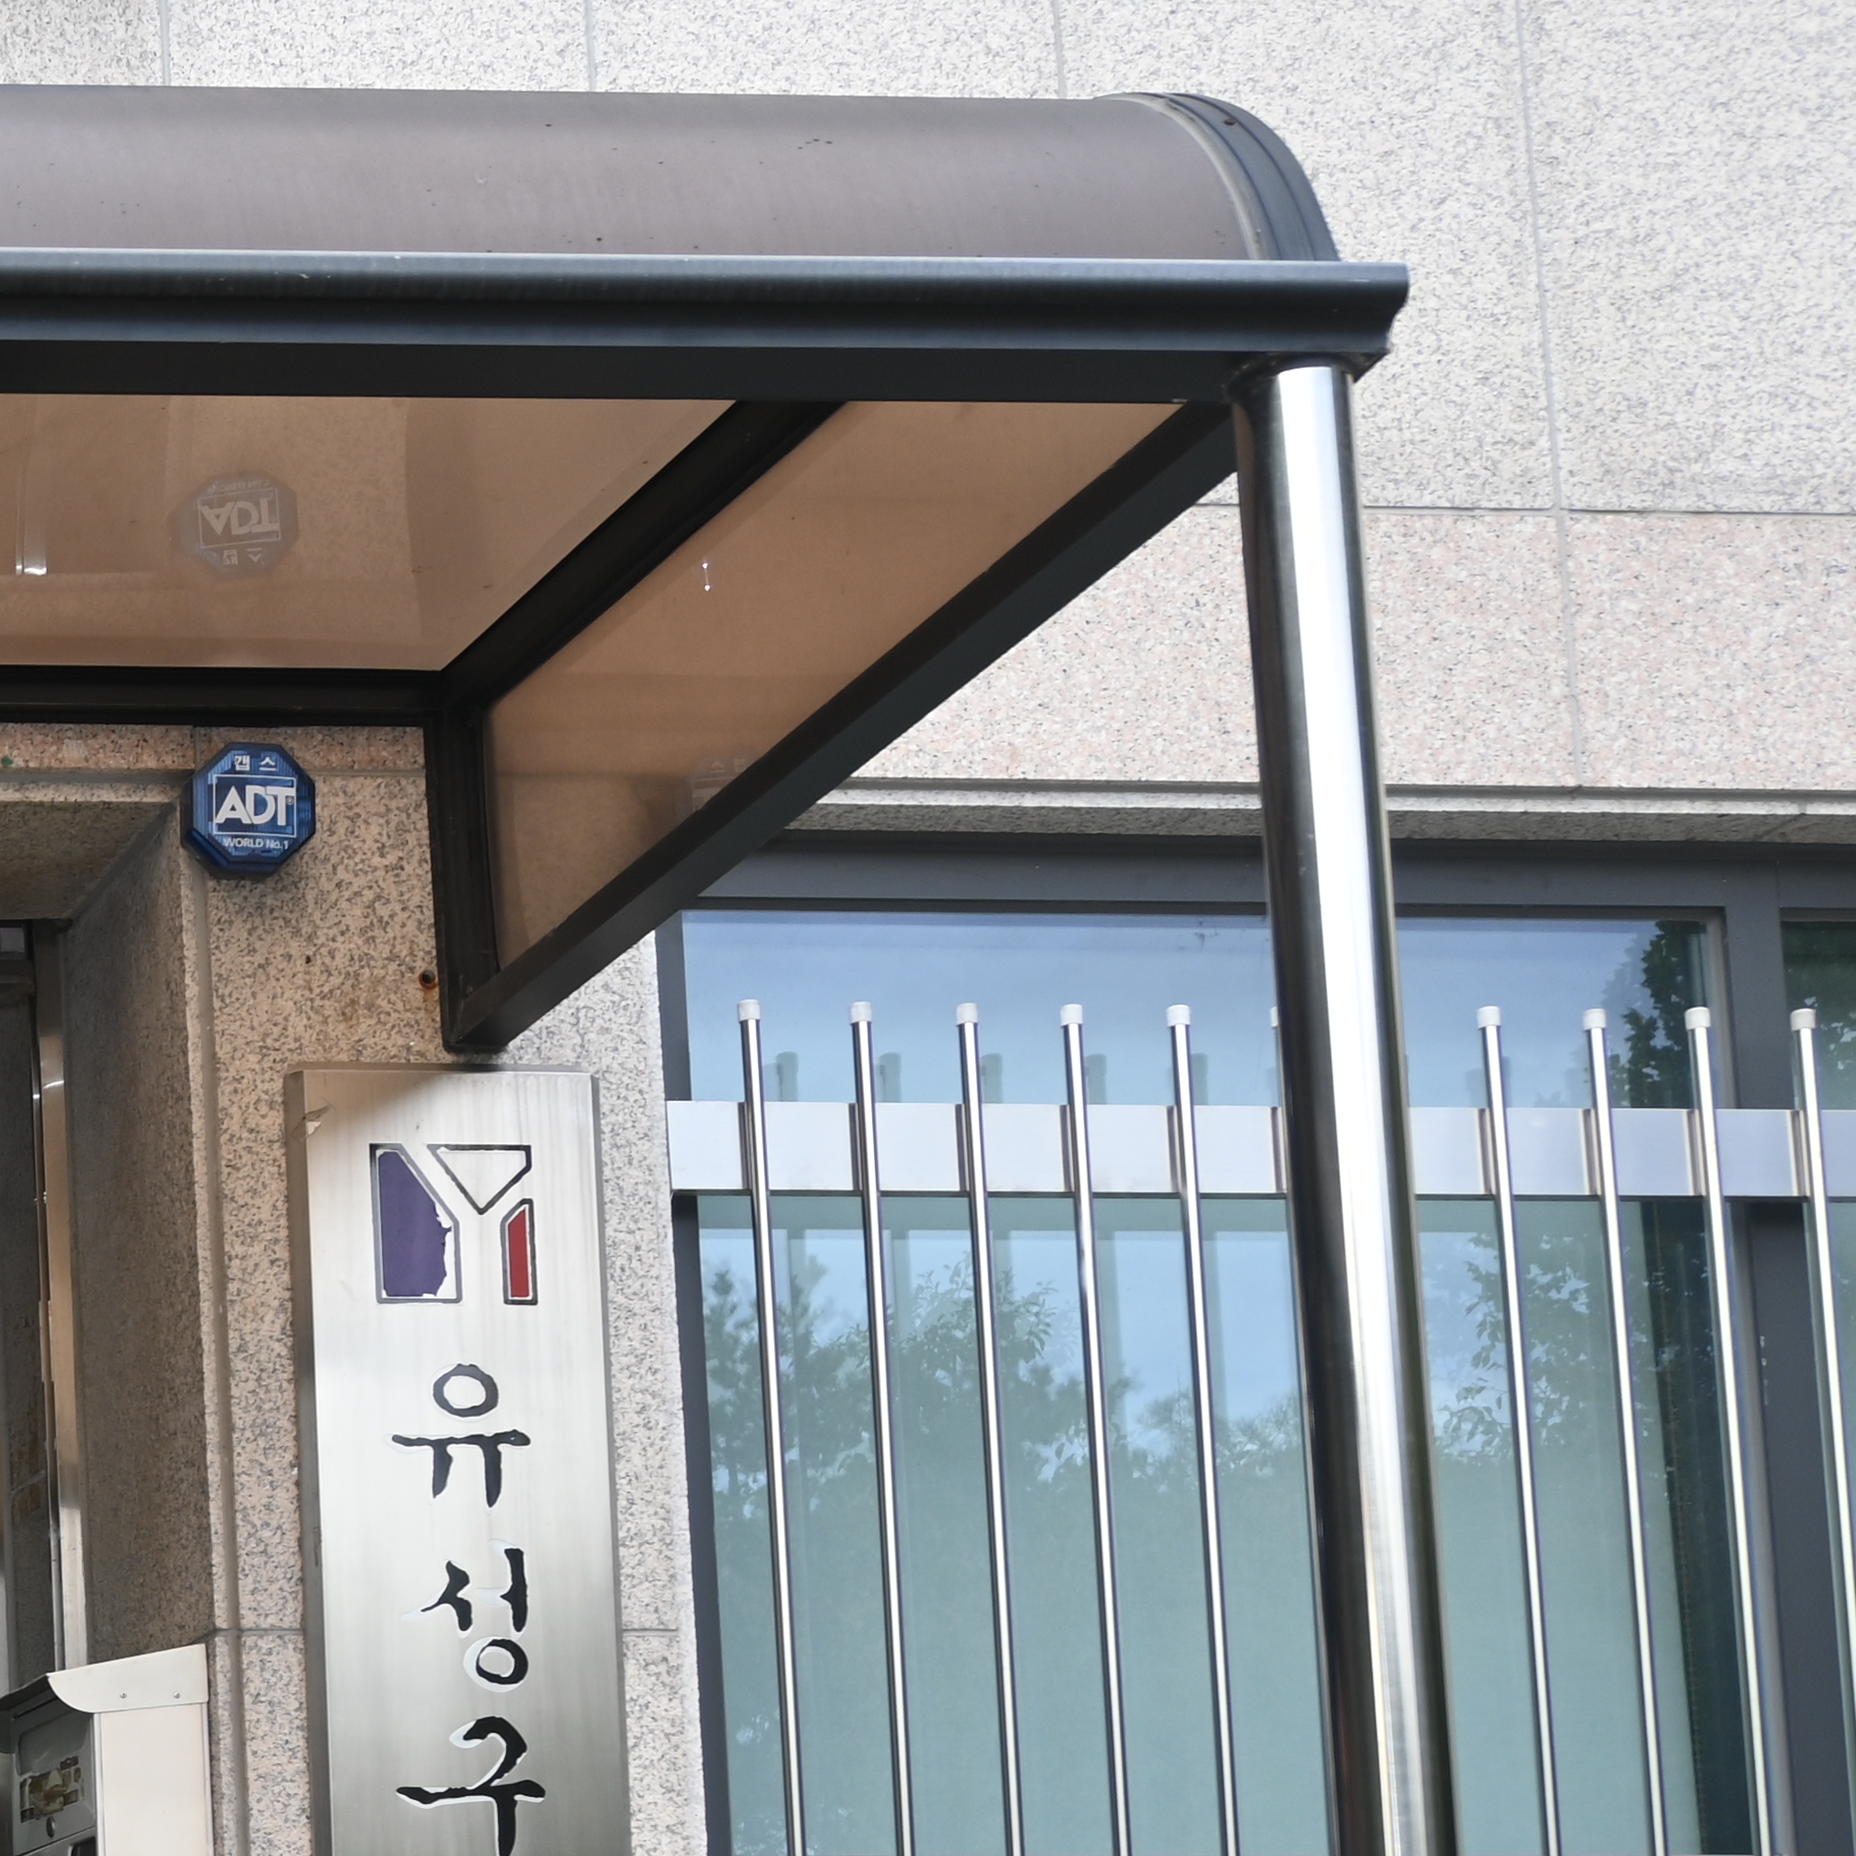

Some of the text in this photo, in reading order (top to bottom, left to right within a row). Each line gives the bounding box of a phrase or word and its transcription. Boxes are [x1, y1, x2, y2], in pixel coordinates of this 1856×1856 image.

[215, 785, 296, 826] ADT
[223, 838, 289, 850] WORLD No.1
